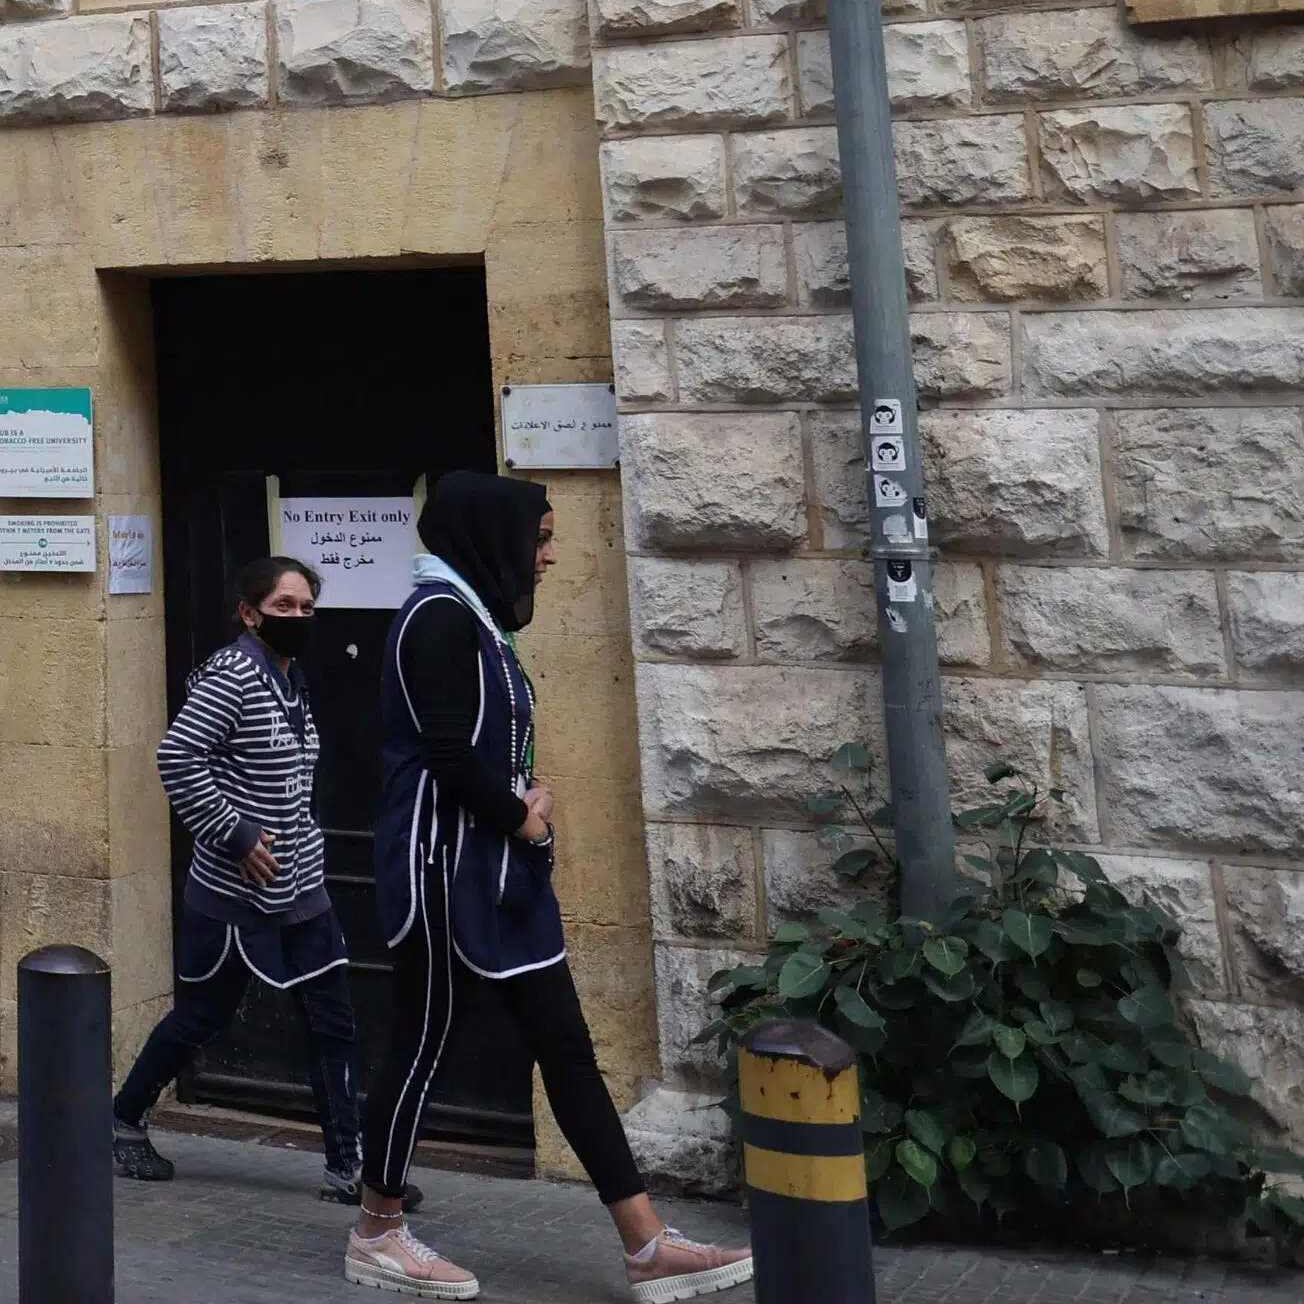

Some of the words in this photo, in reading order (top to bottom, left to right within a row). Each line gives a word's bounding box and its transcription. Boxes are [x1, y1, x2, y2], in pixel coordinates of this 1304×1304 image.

[46, 437, 88, 445] UNIVERSITY
[283, 510, 300, 523] No
[304, 510, 344, 525] Entry
[349, 510, 377, 523] Exit
[381, 509, 410, 525] only
[310, 532, 345, 545] الدخول
[349, 533, 382, 547] ممنوع
[320, 552, 340, 564] فقط
[343, 555, 374, 569] مخرج
